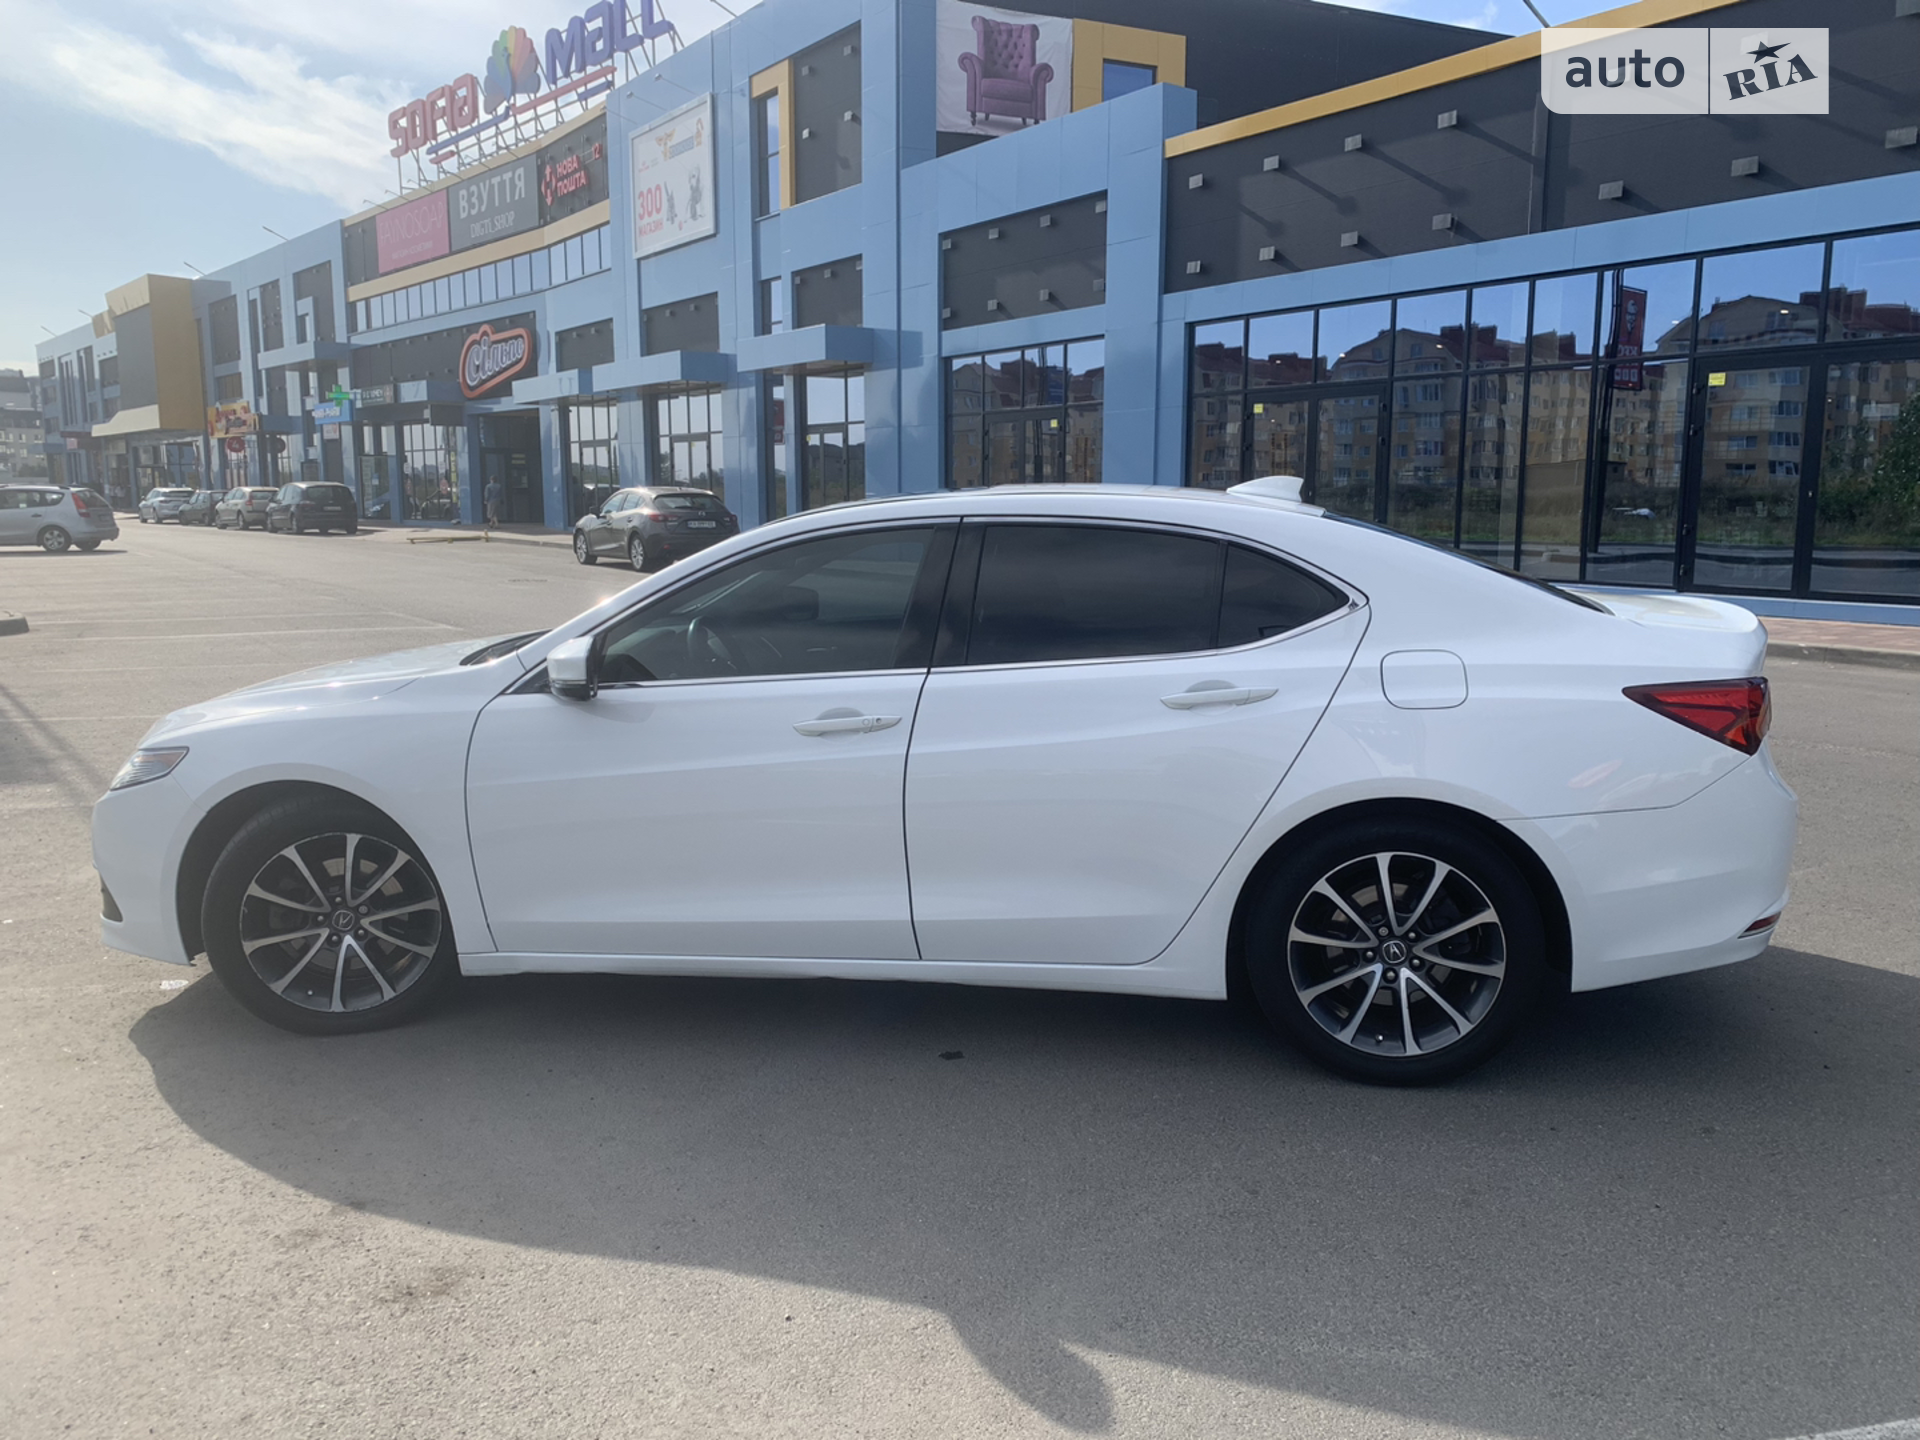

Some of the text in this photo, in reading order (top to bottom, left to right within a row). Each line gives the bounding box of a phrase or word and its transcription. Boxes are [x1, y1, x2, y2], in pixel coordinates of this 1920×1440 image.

[556, 154, 580, 178] НОВА
[556, 169, 588, 197] ПОШТА
[459, 167, 525, 220] ВЗУТТЯ
[638, 183, 662, 221] 300
[465, 335, 525, 387] Сільпо
